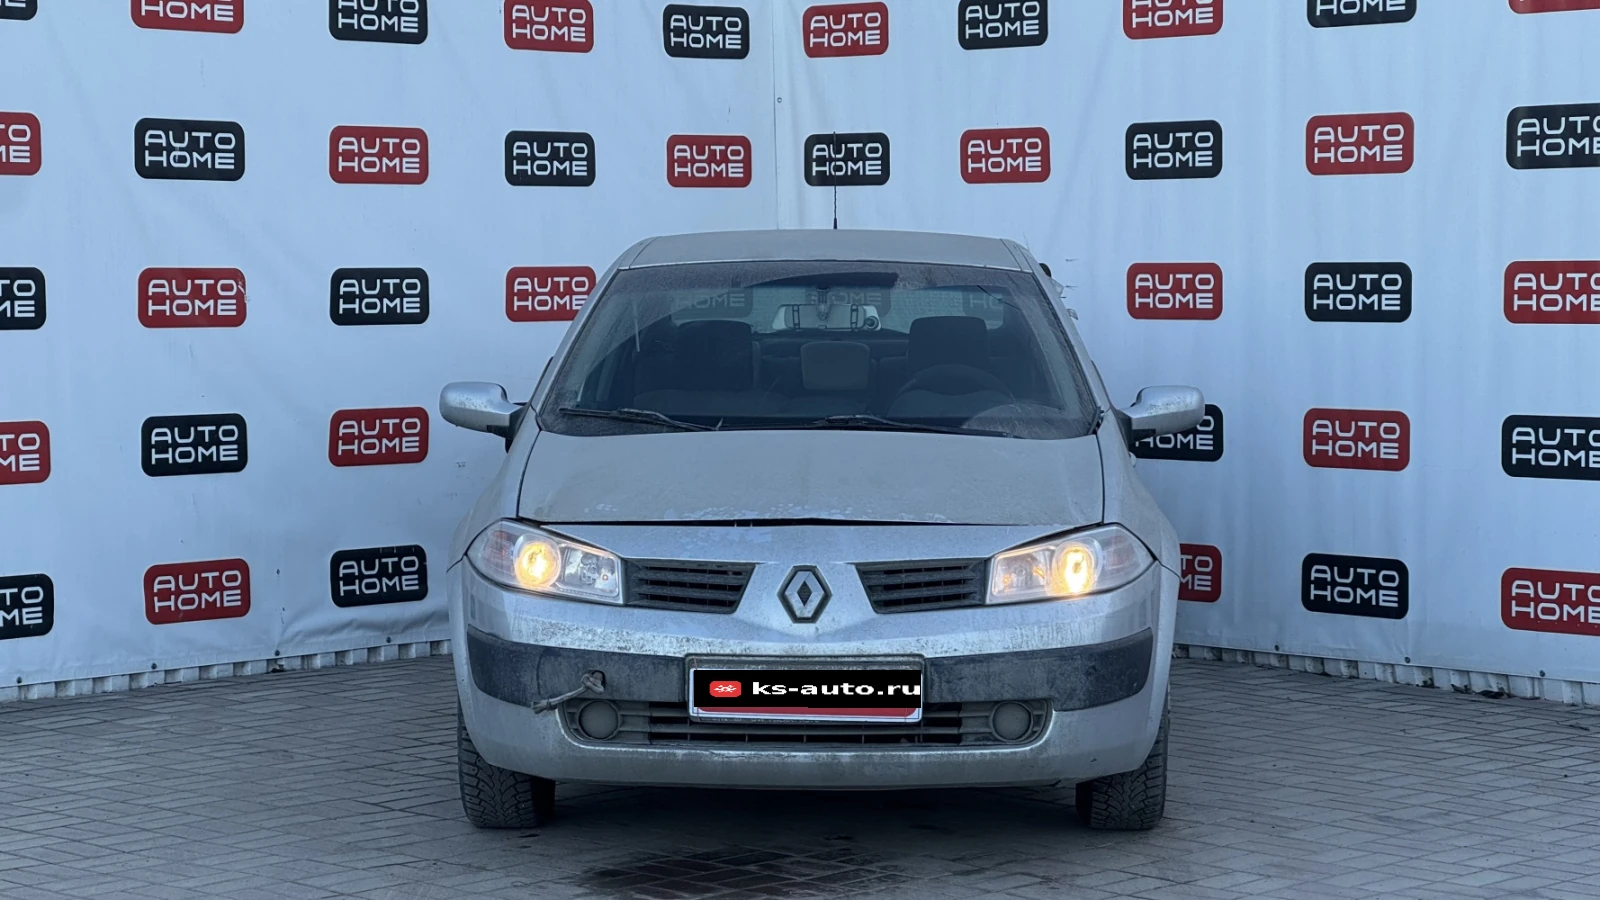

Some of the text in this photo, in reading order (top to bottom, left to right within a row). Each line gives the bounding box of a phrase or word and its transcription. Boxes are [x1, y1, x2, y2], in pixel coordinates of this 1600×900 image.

[141, 0, 234, 21] HOME
[513, 5, 587, 24] AUTO
[966, 2, 1040, 21] AUTO
[1132, 7, 1214, 28] HOME
[338, 13, 419, 32] HOME
[671, 15, 742, 32] AUTO
[811, 13, 881, 31] AUTO
[966, 20, 1040, 40] HOME
[513, 23, 586, 42] HOME
[671, 32, 742, 48] HOME
[810, 30, 881, 48] HOME
[145, 130, 236, 149] AUTO
[1134, 132, 1214, 149] AUTO
[1315, 124, 1405, 143] AUTO
[339, 137, 421, 154] AUTO
[513, 142, 588, 158] AUTO
[674, 145, 745, 160] AUTO
[813, 143, 883, 159] AUTO
[968, 138, 1042, 155] AUTO
[1315, 145, 1403, 163] HOME
[145, 150, 235, 169] HOME
[339, 156, 420, 173] HOME
[513, 160, 588, 176] HOME
[968, 157, 1042, 174] HOME
[1134, 151, 1213, 168] HOME
[674, 163, 744, 178] HOME
[813, 161, 882, 177] HOME
[149, 280, 238, 296] AUTO
[340, 279, 421, 295] AUTO
[513, 277, 589, 293] AUTO
[1136, 274, 1215, 290] AUTO
[1314, 274, 1403, 290] AUTO
[149, 300, 237, 316] HOME
[339, 298, 421, 314] HOME
[513, 295, 589, 311] HOME
[1136, 293, 1214, 309] HOME
[1314, 294, 1401, 310] HOME
[152, 426, 240, 445] AUTO
[339, 419, 421, 437] AUTO
[1313, 420, 1400, 439] AUTO
[152, 445, 239, 465] HOME
[339, 437, 421, 456] HOME
[1313, 440, 1399, 460] HOME
[340, 557, 420, 577] AUTO
[154, 571, 242, 593] AUTO
[340, 575, 419, 596] HOME
[1311, 566, 1399, 587] AUTO
[154, 589, 242, 613] HOME
[1311, 585, 1398, 607] HOME
